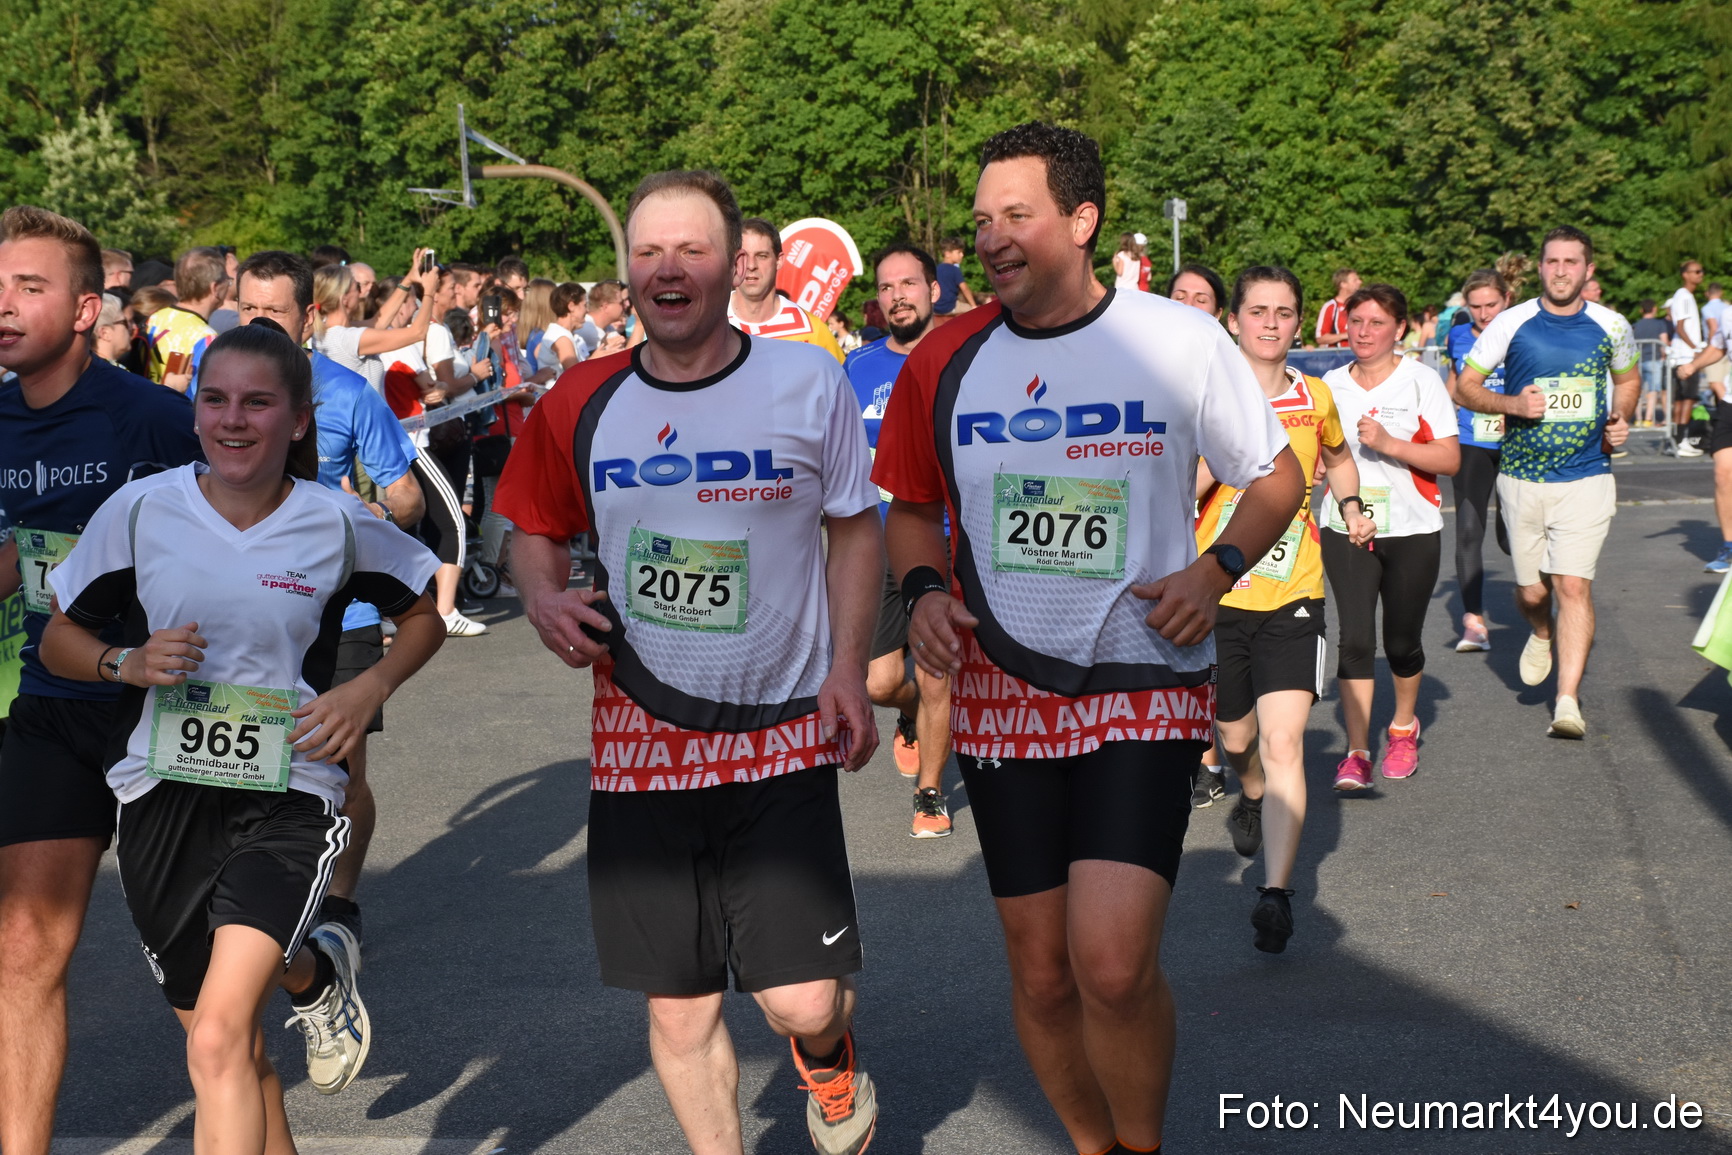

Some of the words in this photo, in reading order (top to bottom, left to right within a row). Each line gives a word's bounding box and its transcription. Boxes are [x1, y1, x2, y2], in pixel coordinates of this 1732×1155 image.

[786, 239, 806, 264] AVIA
[1548, 394, 1582, 409] 200
[50, 462, 108, 488] POLES
[1013, 495, 1064, 505] firmenlauf
[1074, 505, 1091, 513] run
[1094, 505, 1119, 514] 2019
[1007, 510, 1107, 549] 2076
[1021, 546, 1058, 557] Vöstner
[1061, 550, 1093, 560] Martin
[1271, 541, 1288, 562] 5
[286, 570, 307, 580] TEAM
[718, 565, 740, 573] 2019
[257, 574, 300, 584] guttenberger
[270, 581, 317, 593] partner
[638, 564, 731, 607] 2075
[653, 600, 676, 612] Stark
[680, 605, 712, 616] Robert
[663, 612, 678, 620] Rödl
[679, 614, 699, 622] GmbH
[961, 667, 1024, 700] AVIA
[175, 697, 231, 714] firmenlauf
[977, 700, 1047, 735] AVIA
[1055, 692, 1136, 734] AVIA
[240, 714, 258, 723] run
[260, 716, 286, 725] 2019
[180, 717, 261, 760] 965
[600, 735, 672, 768] AVIA
[681, 733, 755, 766] AVIA
[176, 754, 240, 770] Schmidbaur
[243, 762, 260, 772] Pia
[168, 765, 213, 777] guttenberger
[214, 771, 241, 780] partner
[242, 772, 265, 781] GmbH
